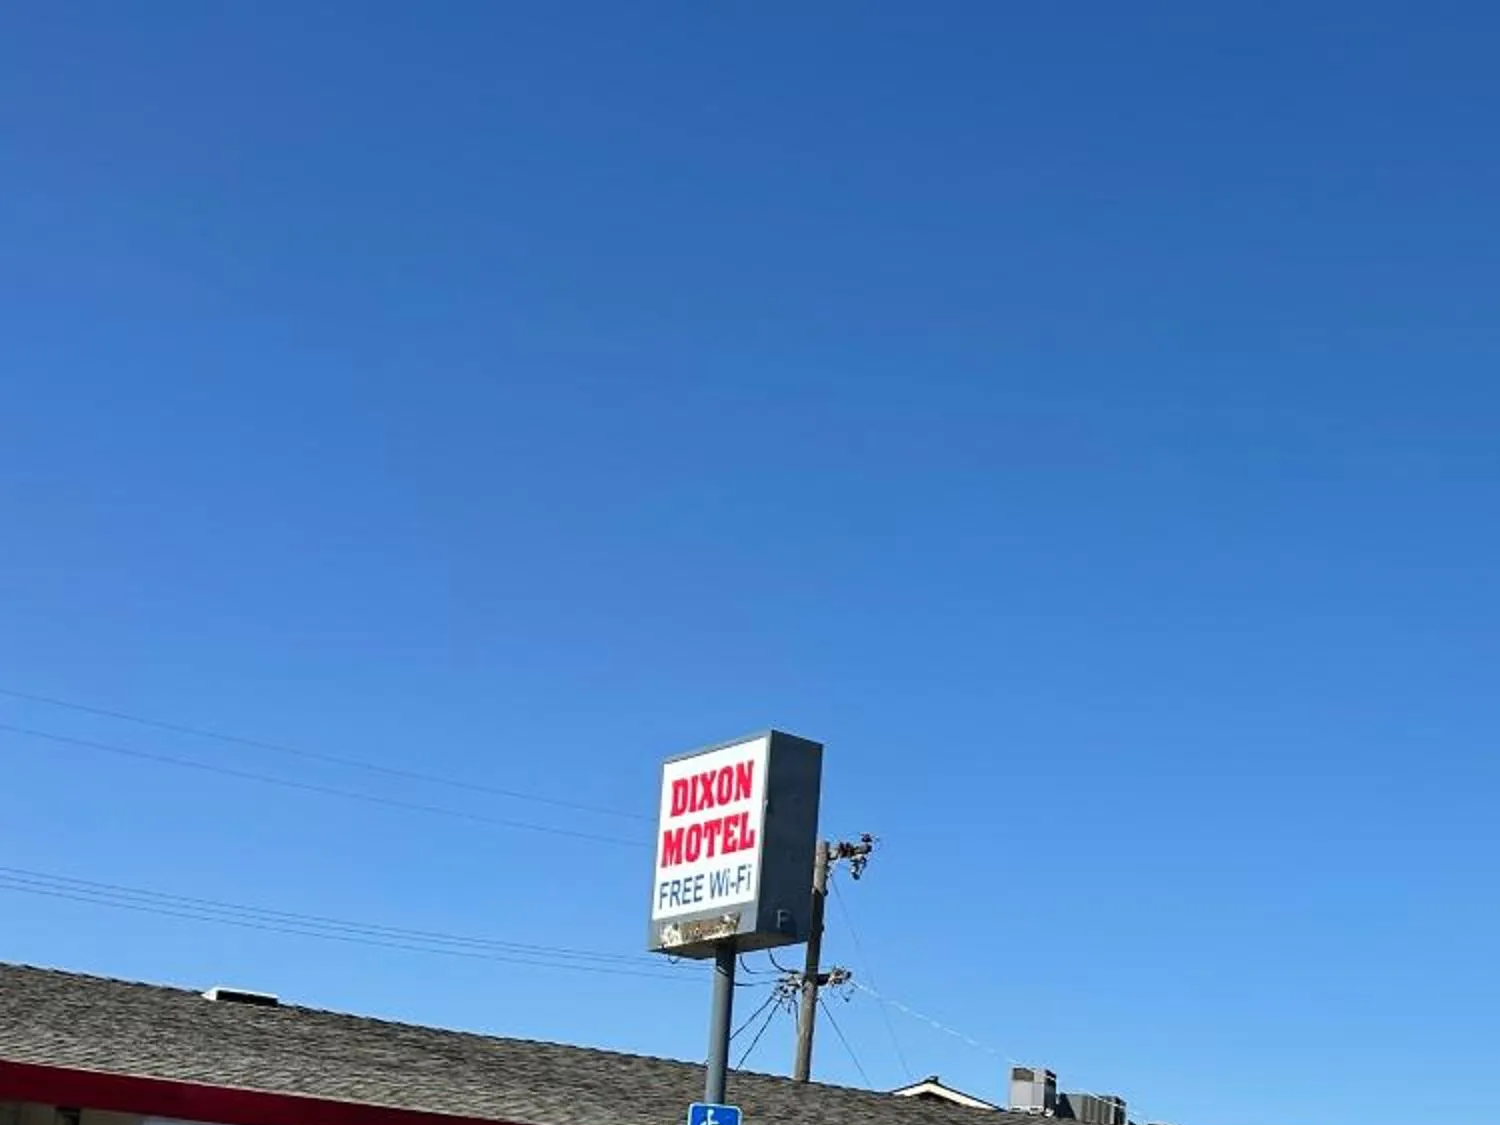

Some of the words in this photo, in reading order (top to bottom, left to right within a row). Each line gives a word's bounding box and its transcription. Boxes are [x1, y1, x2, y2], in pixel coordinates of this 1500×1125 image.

[670, 759, 754, 817] DIXON
[661, 811, 755, 868] MOTEL
[659, 874, 704, 909] FREE
[709, 864, 752, 899] Wi-Fi
